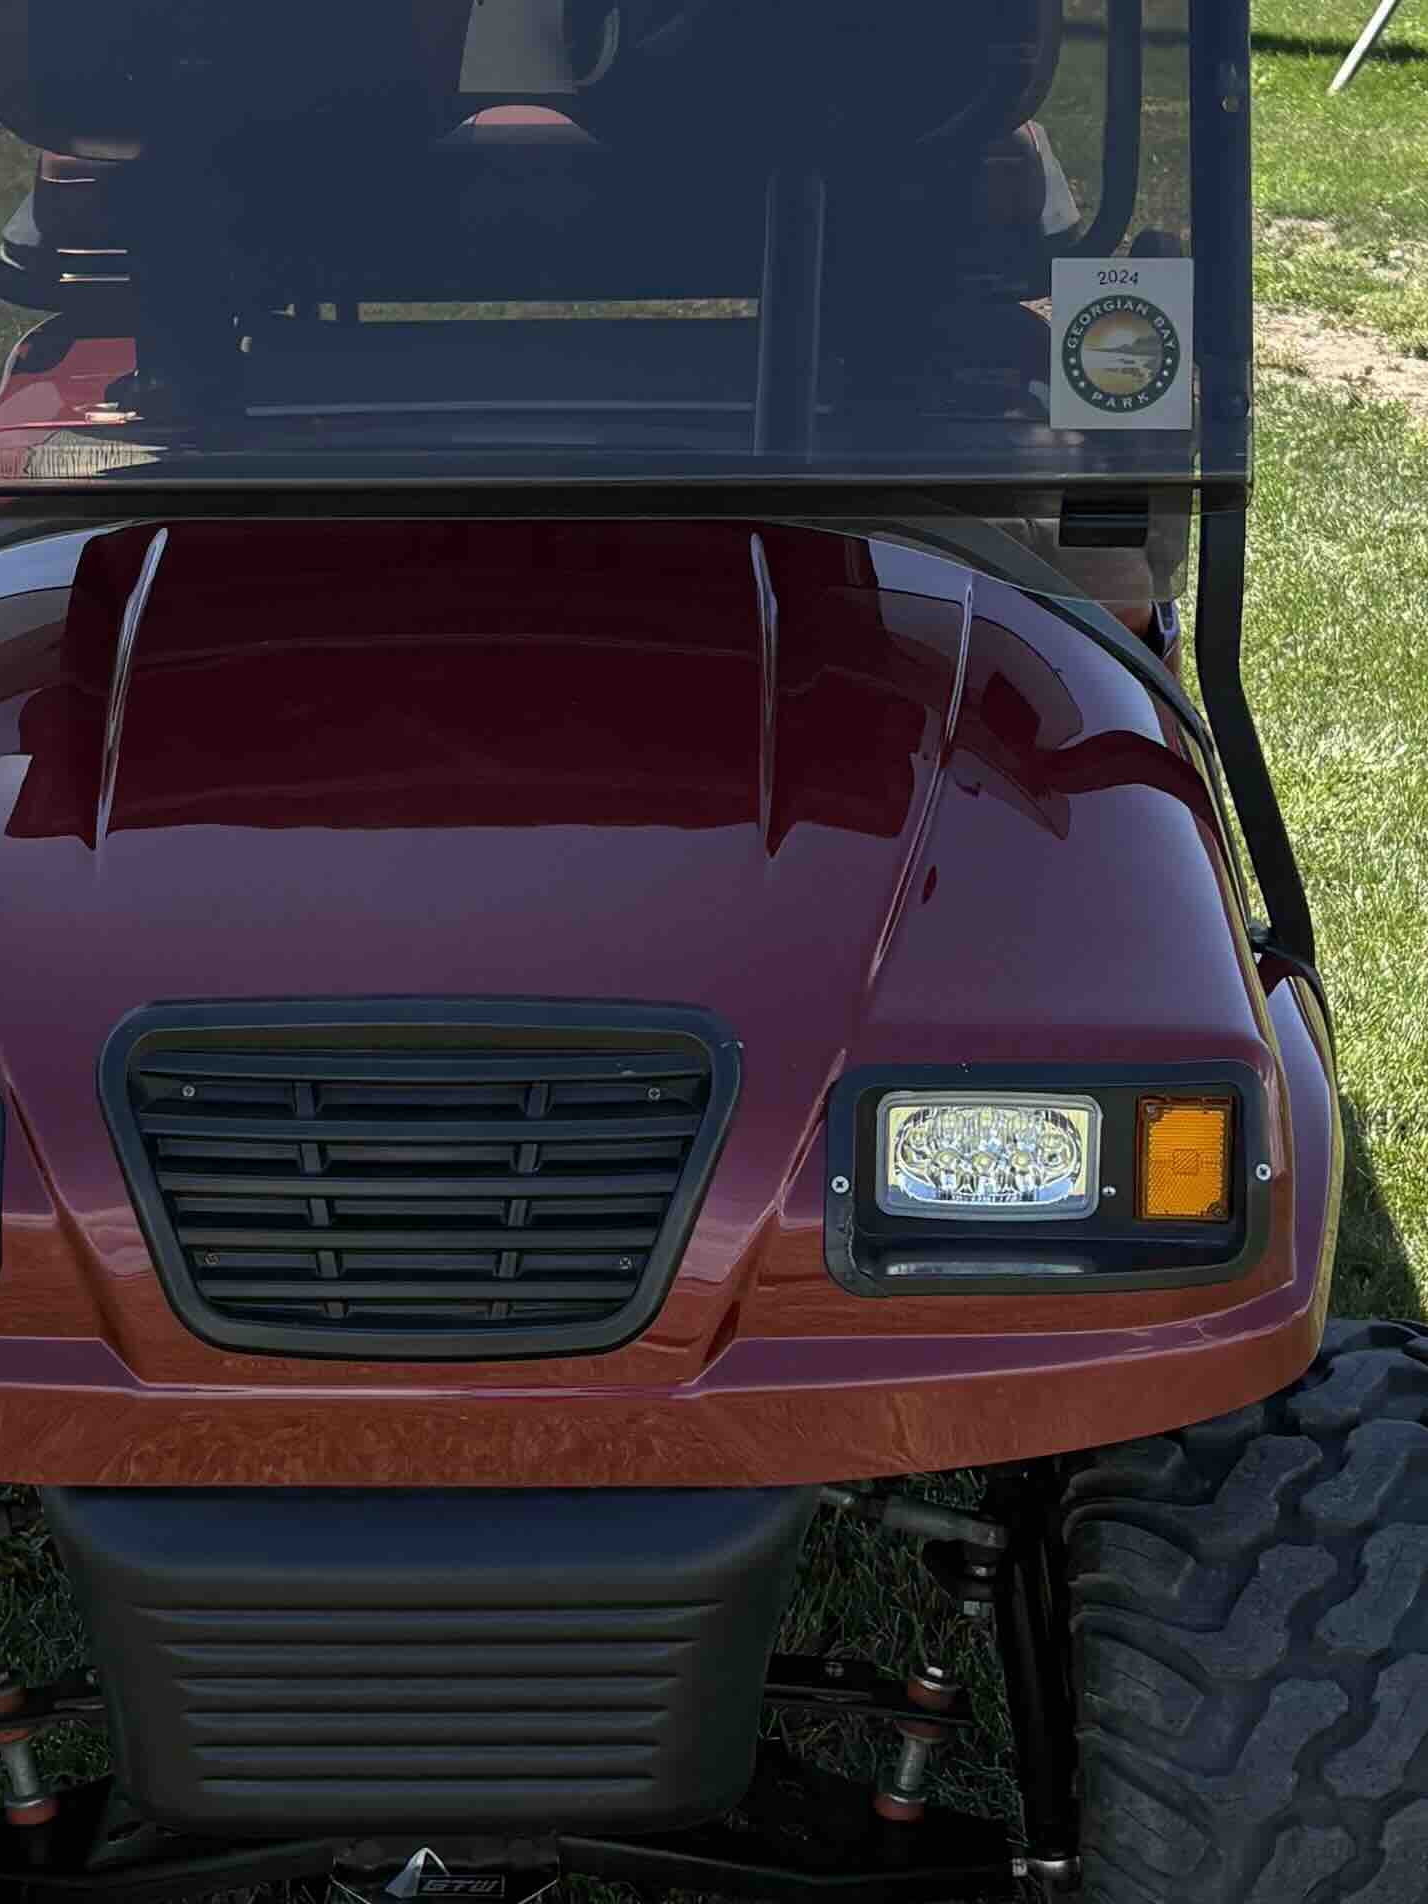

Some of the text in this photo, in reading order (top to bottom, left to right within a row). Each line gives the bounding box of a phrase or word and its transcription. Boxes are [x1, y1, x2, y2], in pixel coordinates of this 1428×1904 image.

[1097, 269, 1139, 285] 2024
[1067, 299, 1177, 350] GEORGIAN BAY
[1092, 392, 1149, 409] PARK
